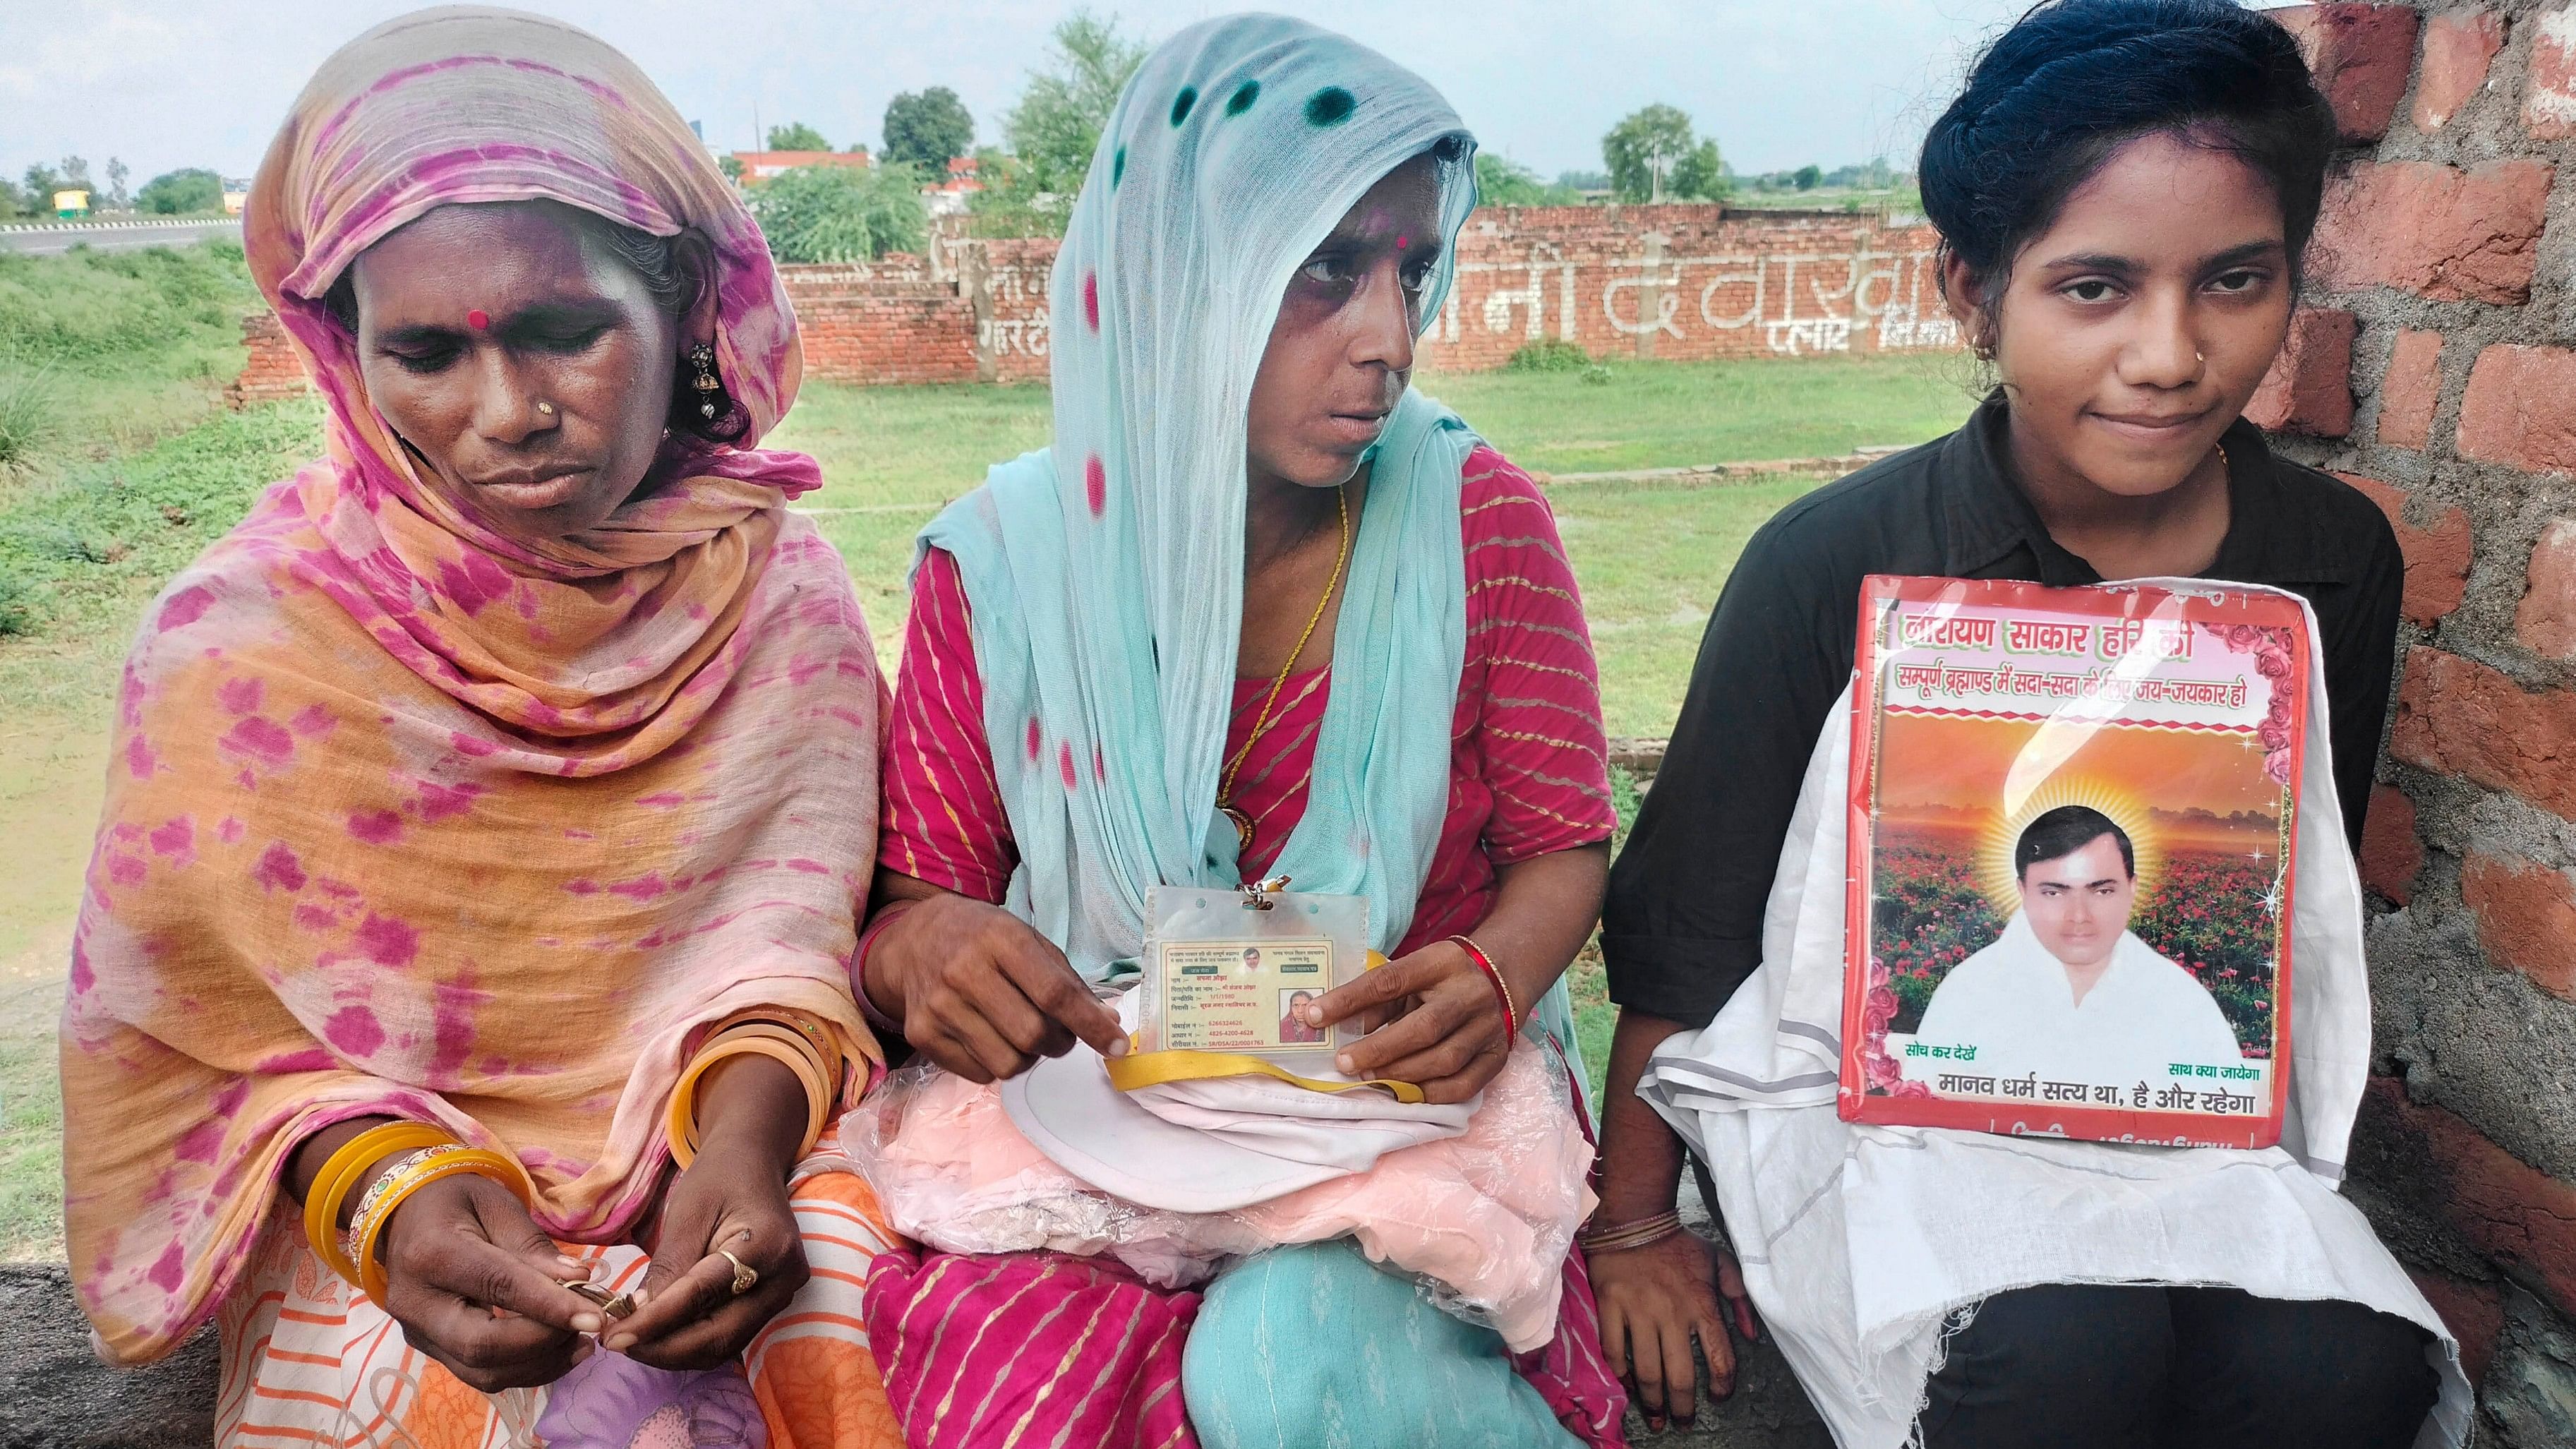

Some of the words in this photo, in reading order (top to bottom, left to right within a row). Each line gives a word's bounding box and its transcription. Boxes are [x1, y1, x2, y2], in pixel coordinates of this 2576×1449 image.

[1906, 615, 1996, 647] नारायण
[2010, 621, 2090, 653] साकार
[2102, 618, 2143, 656] हरि
[2159, 620, 2195, 657] की
[1898, 661, 1942, 697] सम्पूर्ण
[1946, 669, 1994, 695] ब्रह्माण्ड
[1997, 665, 2013, 692] में
[2014, 673, 2080, 696] सदा-सदा
[2083, 671, 2100, 697] के
[2105, 670, 2131, 699] लिए
[2136, 680, 2228, 705] जय-जयकार
[2230, 678, 2248, 707] हो
[1905, 1041, 1928, 1057] सोच
[1932, 1046, 1951, 1059] कर
[1954, 1044, 1977, 1061] देखें
[2168, 1063, 2192, 1076] साथ
[2196, 1065, 2217, 1078] क्या
[2220, 1064, 2260, 1081] जायेगा
[1939, 1073, 1996, 1095] मानव
[2002, 1071, 2037, 1098] धर्म
[2042, 1081, 2088, 1102] सत्य
[2094, 1086, 2124, 1107] था,
[2132, 1081, 2150, 1108] है
[2155, 1083, 2196, 1110] और
[2200, 1087, 2256, 1114] रहेगा
